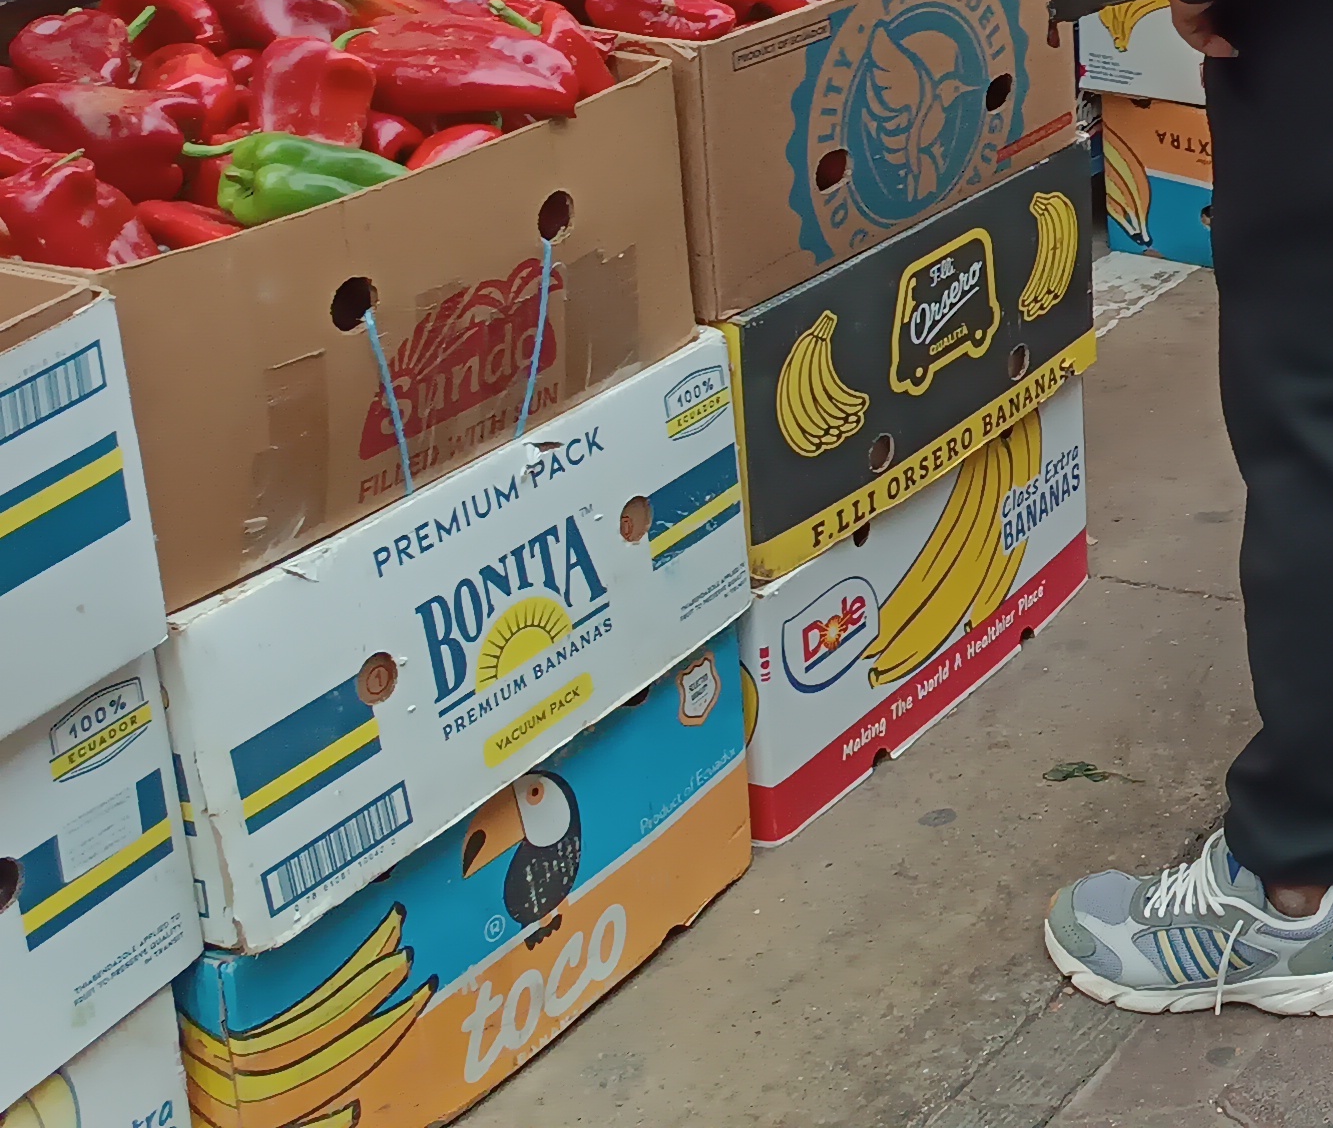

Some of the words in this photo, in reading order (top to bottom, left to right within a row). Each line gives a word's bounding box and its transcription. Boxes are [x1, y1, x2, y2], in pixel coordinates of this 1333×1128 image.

[1155, 129, 1212, 157] XTRA
[910, 260, 983, 345] Orsero
[676, 376, 715, 409] 100%
[811, 489, 878, 549] F.LLI
[886, 426, 973, 500] ORSERO
[981, 357, 1076, 438] BANANAS
[1002, 478, 1040, 520] Class
[1044, 445, 1080, 485] Extra
[372, 474, 520, 579] PREMIUM
[525, 426, 605, 489] PACK
[1002, 463, 1081, 552] BANANAS
[414, 514, 608, 705] BONITA
[802, 594, 867, 663] Dole
[442, 673, 528, 742] PREMIUM
[532, 617, 613, 681] BANANAS
[842, 717, 887, 761] Making
[890, 695, 914, 720] The
[915, 665, 950, 700] World
[954, 652, 963, 672] A
[966, 610, 1015, 660] Healthier
[1018, 584, 1045, 616] Place
[68, 693, 128, 739] 100%
[68, 714, 139, 765] ECUADOR
[495, 707, 547, 751] VACUUM
[549, 685, 581, 716] PACK
[639, 792, 682, 835] Product
[684, 778, 694, 798] of
[461, 903, 627, 1084] toco
